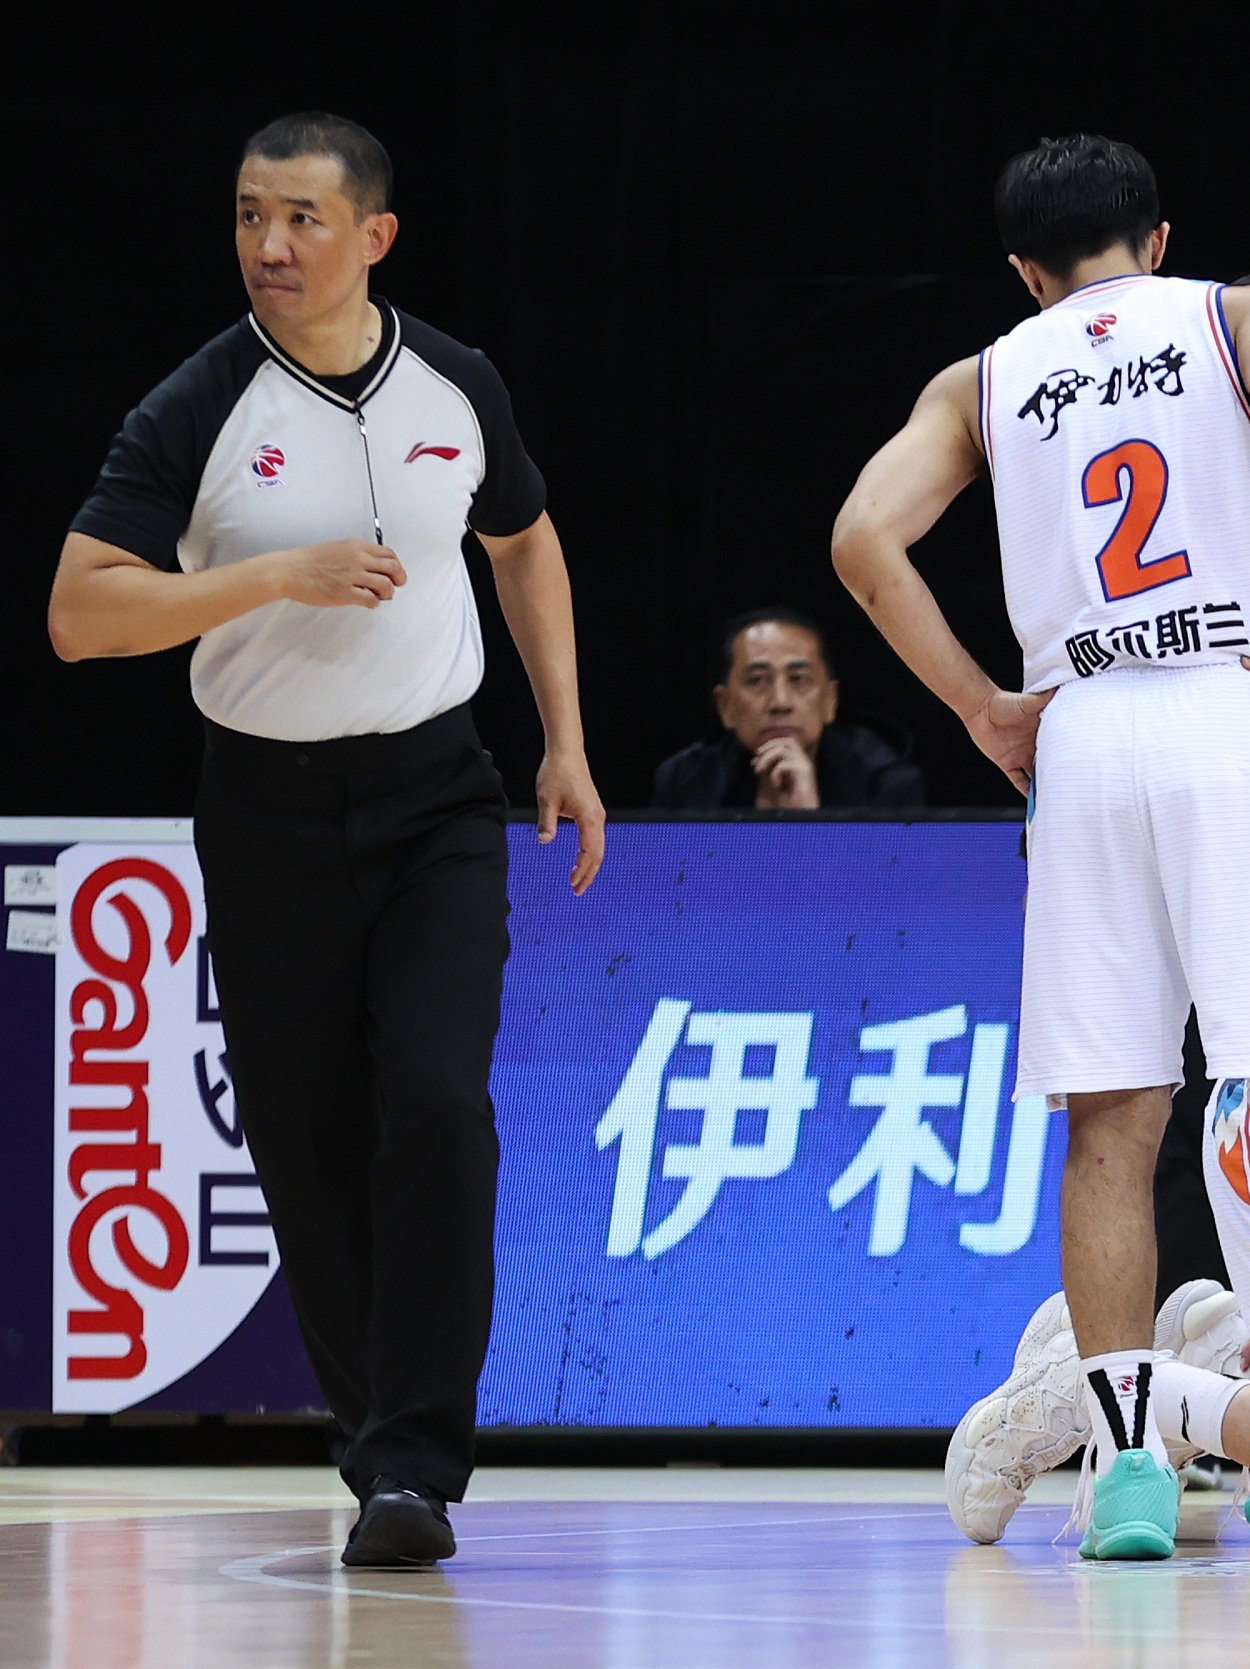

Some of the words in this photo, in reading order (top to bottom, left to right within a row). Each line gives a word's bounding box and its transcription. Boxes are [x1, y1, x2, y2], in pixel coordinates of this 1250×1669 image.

[1017, 343, 1187, 442] 伊力特
[1081, 438, 1193, 603] 2
[1065, 601, 1249, 678] 阿尔斯兰
[67, 857, 192, 1381] Ganten
[595, 997, 1050, 1261] 伊利
